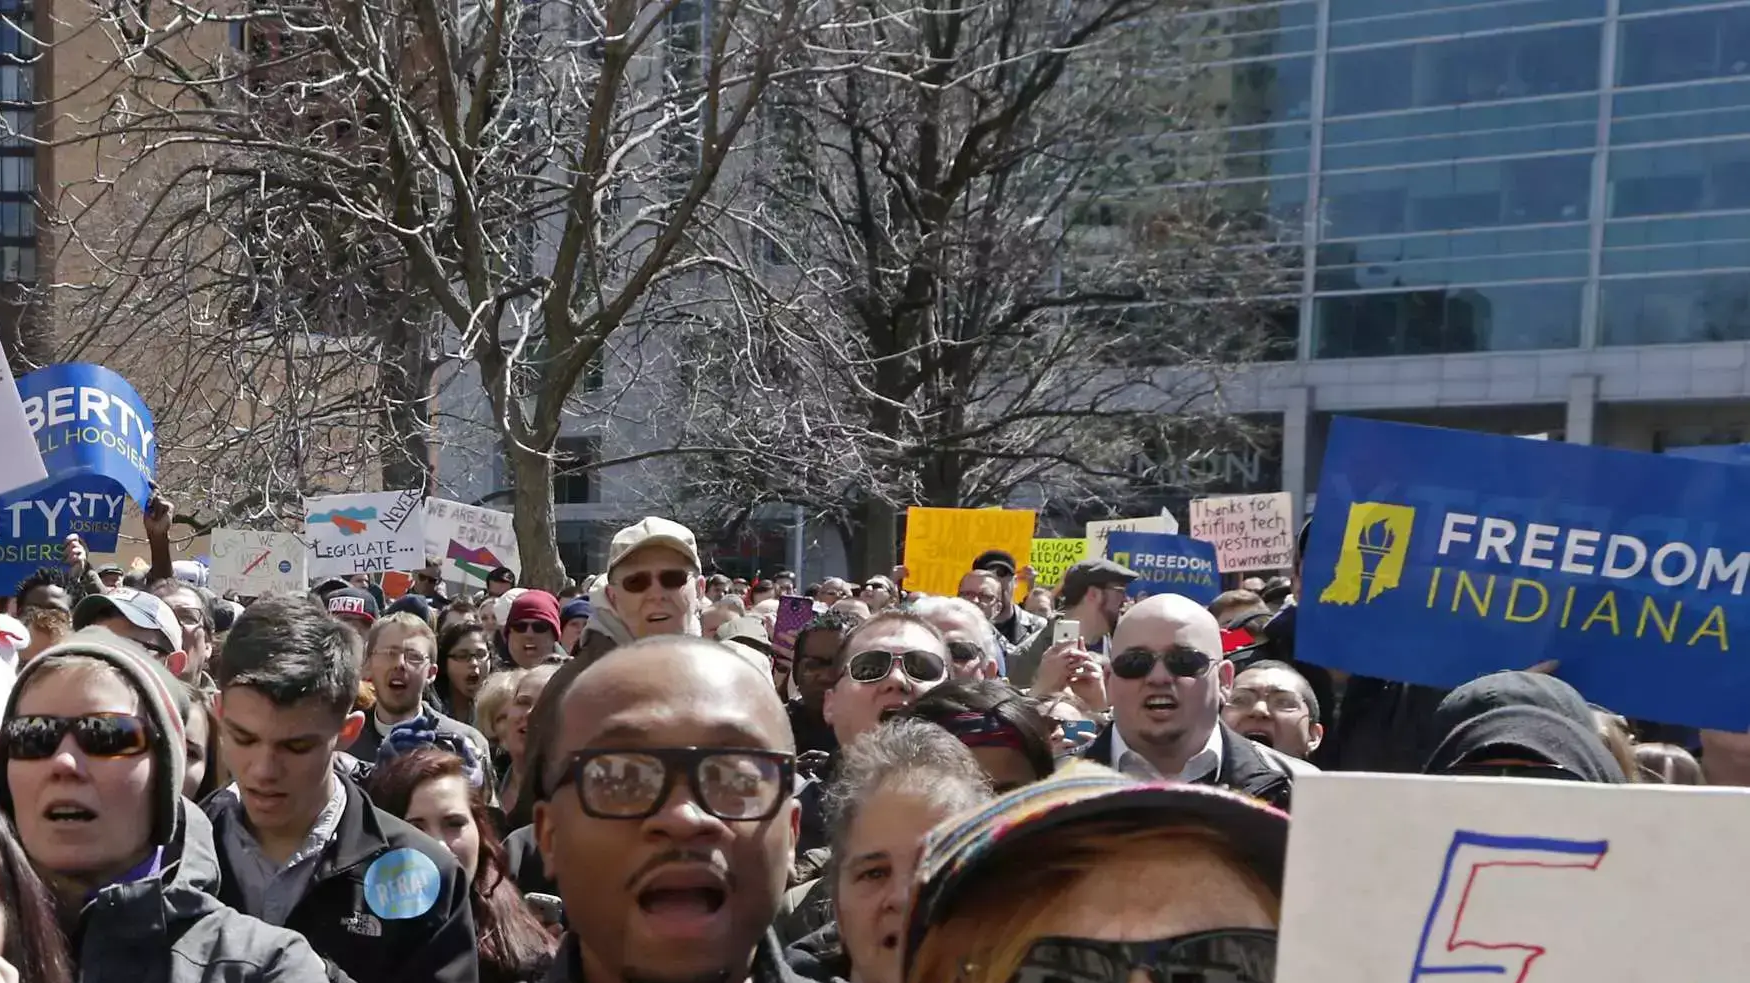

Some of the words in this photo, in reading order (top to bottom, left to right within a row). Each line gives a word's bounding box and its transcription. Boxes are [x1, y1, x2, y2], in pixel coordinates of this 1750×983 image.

[22, 386, 155, 459] BERTY
[65, 426, 154, 482] HOOSIERS
[68, 491, 123, 518] RTY
[379, 487, 422, 531] NEVER
[1193, 499, 1244, 518] Thanks
[1249, 493, 1275, 511] for
[68, 519, 118, 533] OSIERS
[1250, 510, 1287, 532] tech
[1036, 541, 1084, 554] IGIOUS
[1437, 511, 1750, 596] FREEDOM
[353, 556, 395, 573] HATE
[1134, 552, 1213, 572] FREEDOM
[1138, 568, 1214, 587] NDIANA
[1426, 566, 1730, 652] INDIANA
